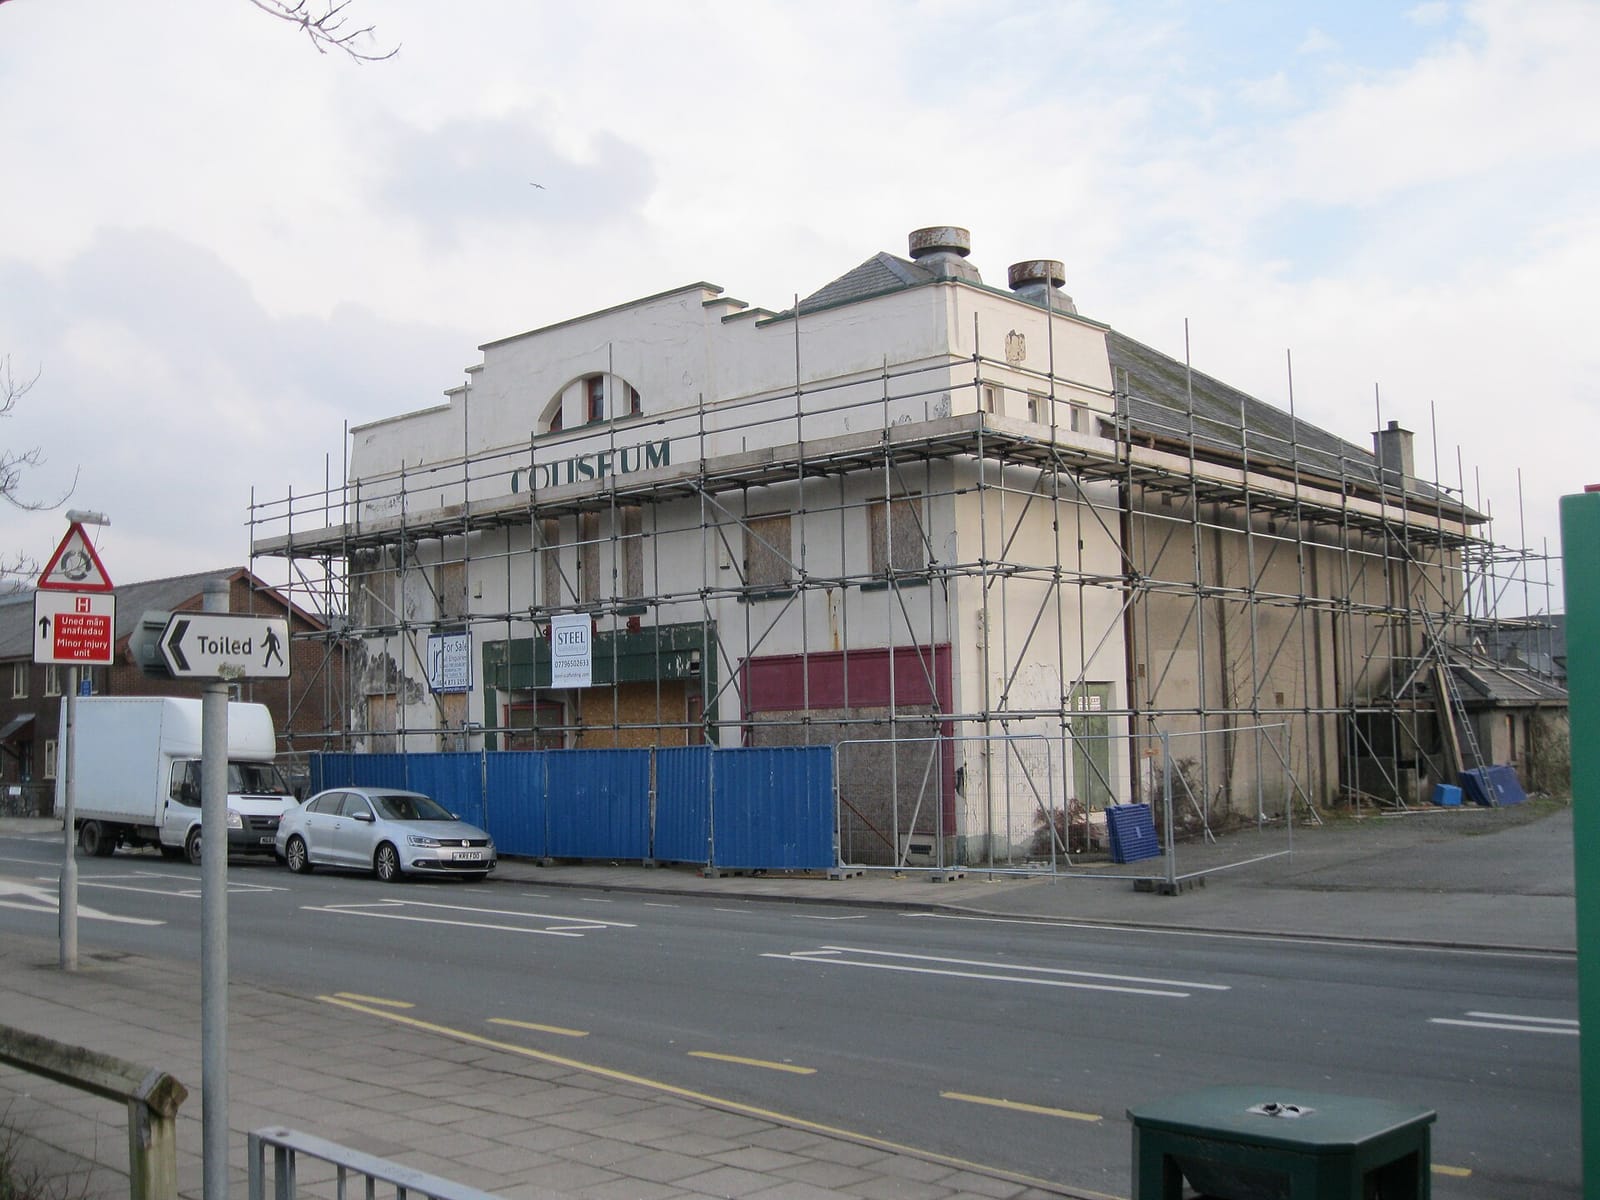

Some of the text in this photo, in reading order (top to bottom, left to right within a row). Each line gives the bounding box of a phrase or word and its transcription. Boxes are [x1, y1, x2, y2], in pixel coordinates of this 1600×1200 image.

[78, 598, 89, 612] H
[61, 616, 104, 627] Uned mân
[61, 627, 103, 637] anafiadau
[558, 631, 585, 645] STEEL
[57, 638, 108, 651] Minor injury
[197, 635, 252, 655] Toiled
[74, 649, 90, 657] unit
